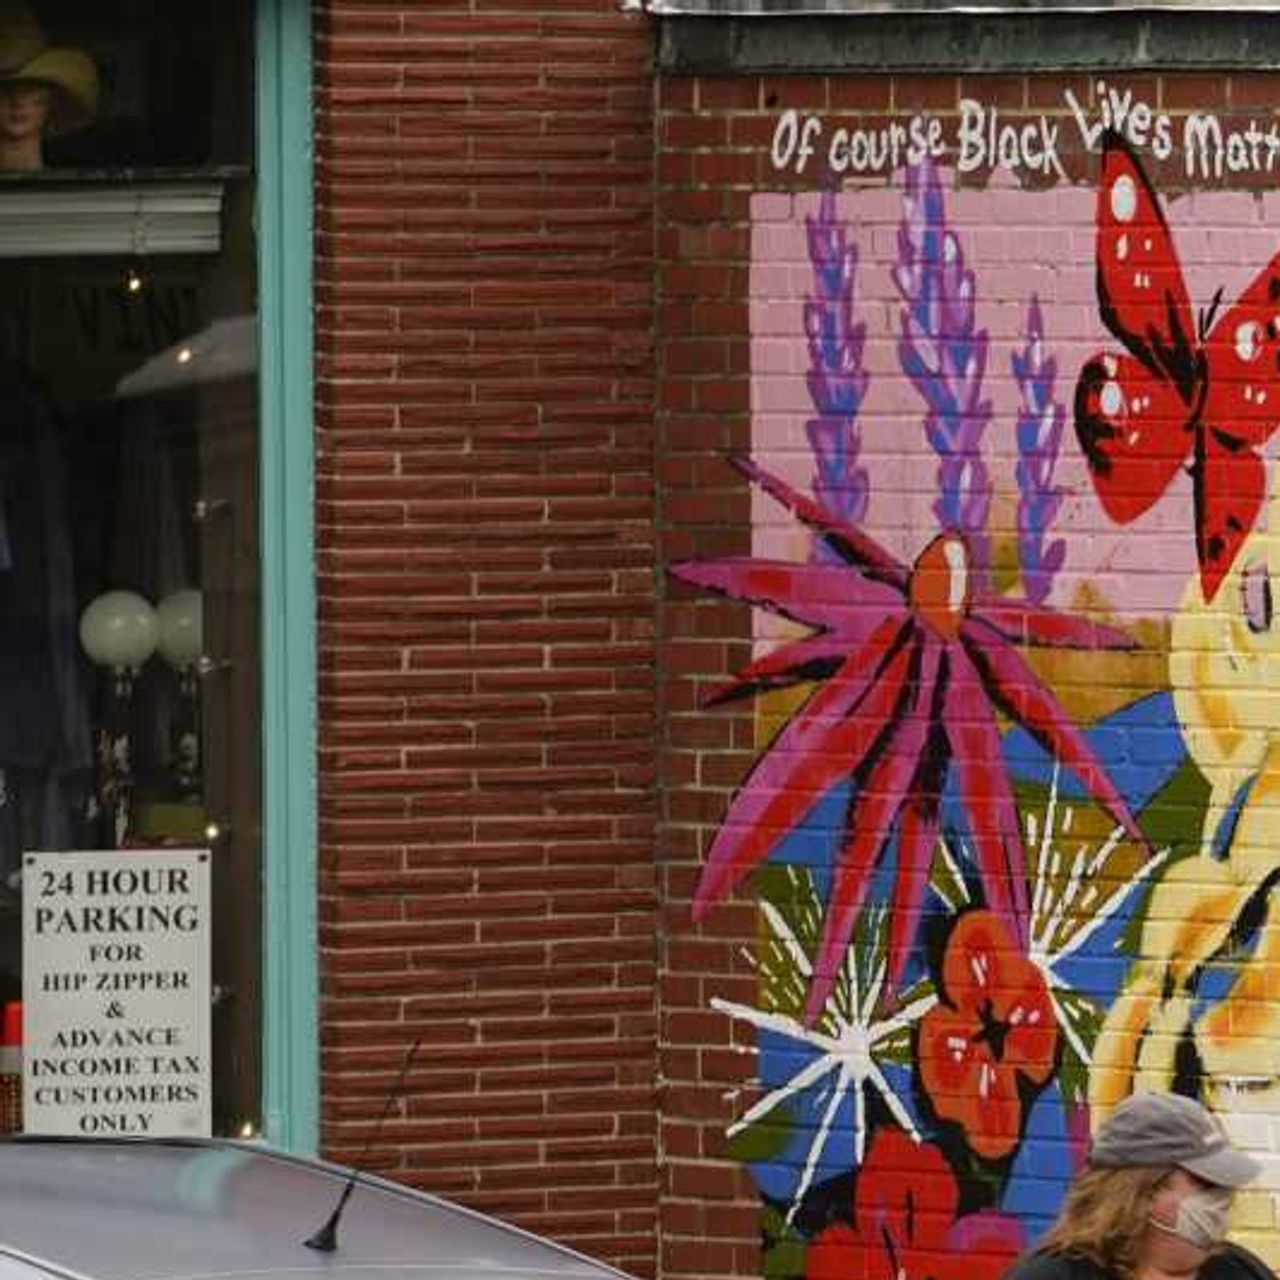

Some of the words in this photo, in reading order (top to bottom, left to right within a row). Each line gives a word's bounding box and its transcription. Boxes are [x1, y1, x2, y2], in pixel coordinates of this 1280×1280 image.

[771, 108, 822, 175] Of
[829, 115, 948, 172] course
[957, 98, 1070, 182] Black
[1064, 79, 1173, 161] Lives
[41, 870, 74, 897] 24
[87, 868, 189, 896] HOUR
[35, 905, 199, 934] PARKING
[89, 944, 144, 962] FOR
[43, 973, 88, 992] HIP
[96, 971, 190, 991] ZIPPER
[106, 1001, 124, 1019] &
[52, 1027, 181, 1049] ADVANCE
[31, 1057, 141, 1077] INCOME
[150, 1055, 200, 1075] TAX
[34, 1084, 199, 1105] CUSTOMERS
[79, 1113, 153, 1133] ONLY
